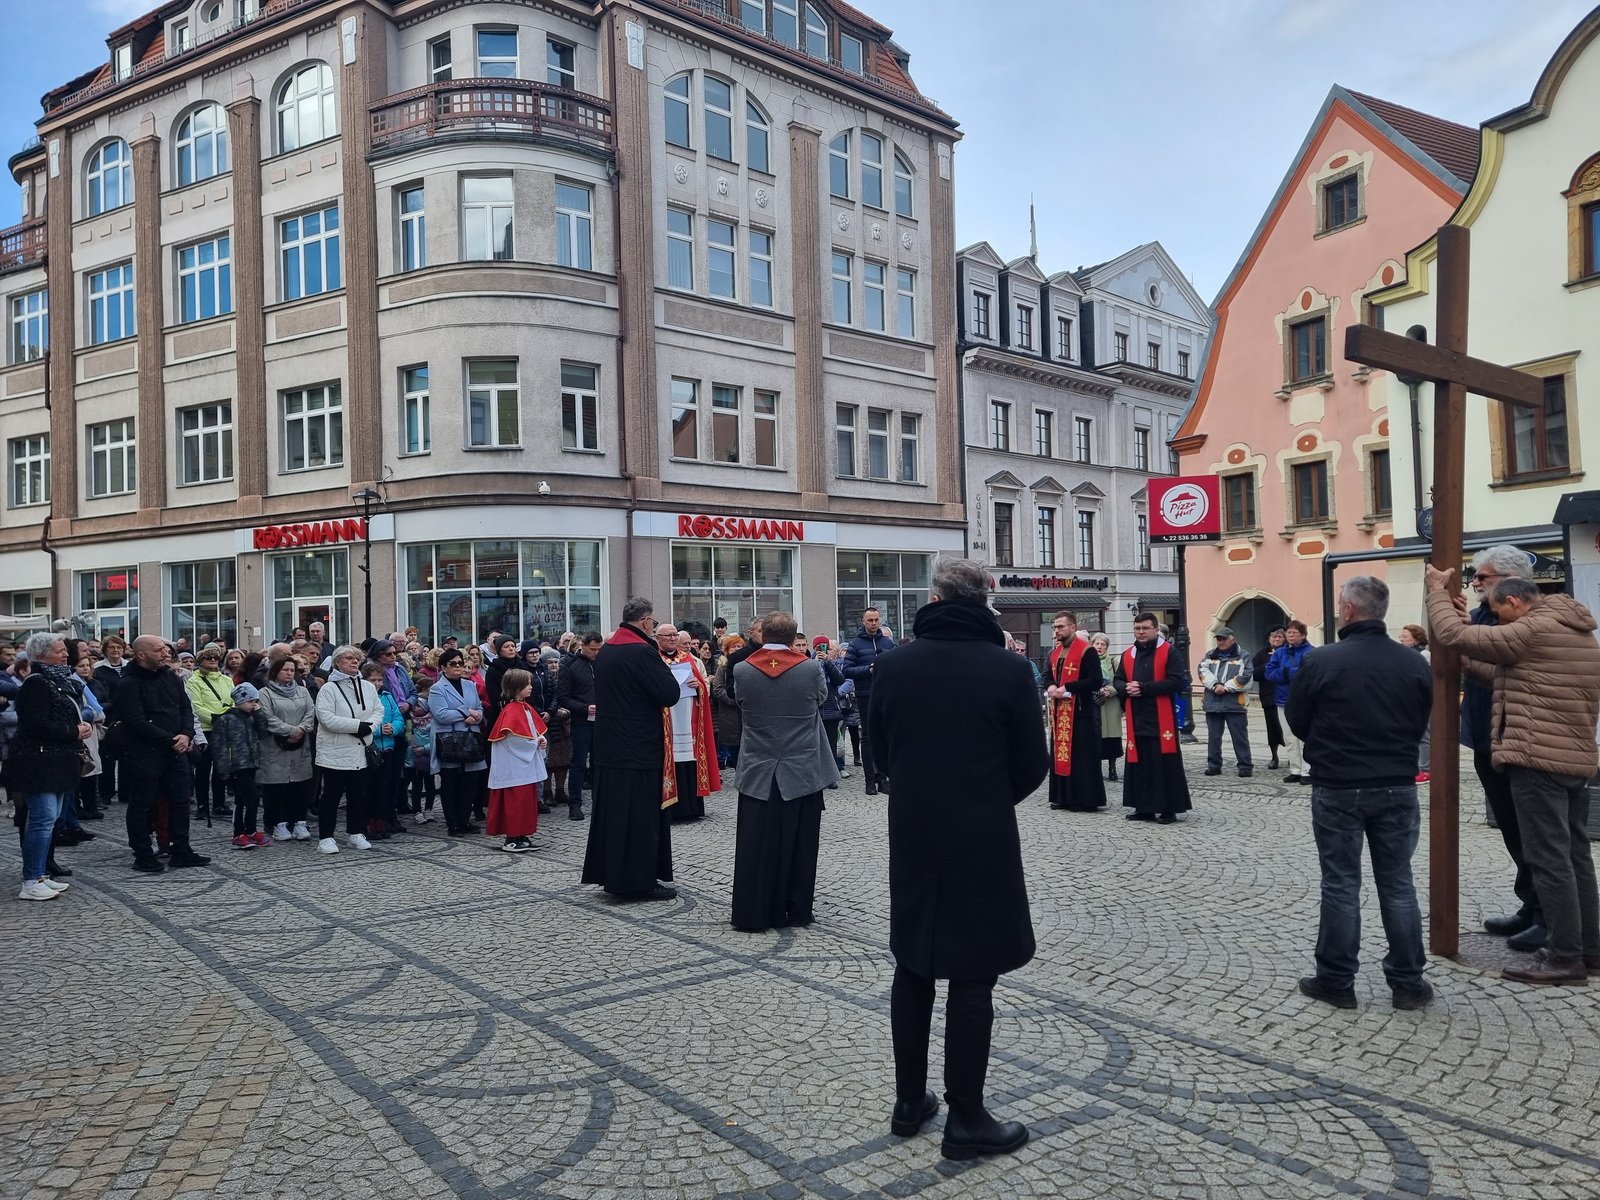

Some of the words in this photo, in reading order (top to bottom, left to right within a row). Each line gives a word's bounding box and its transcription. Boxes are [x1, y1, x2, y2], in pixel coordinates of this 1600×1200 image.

[1169, 501, 1197, 513] Pizza
[1174, 508, 1196, 519] Hut
[253, 517, 367, 550] ROSSMANN
[677, 514, 804, 541] ROSSMANN
